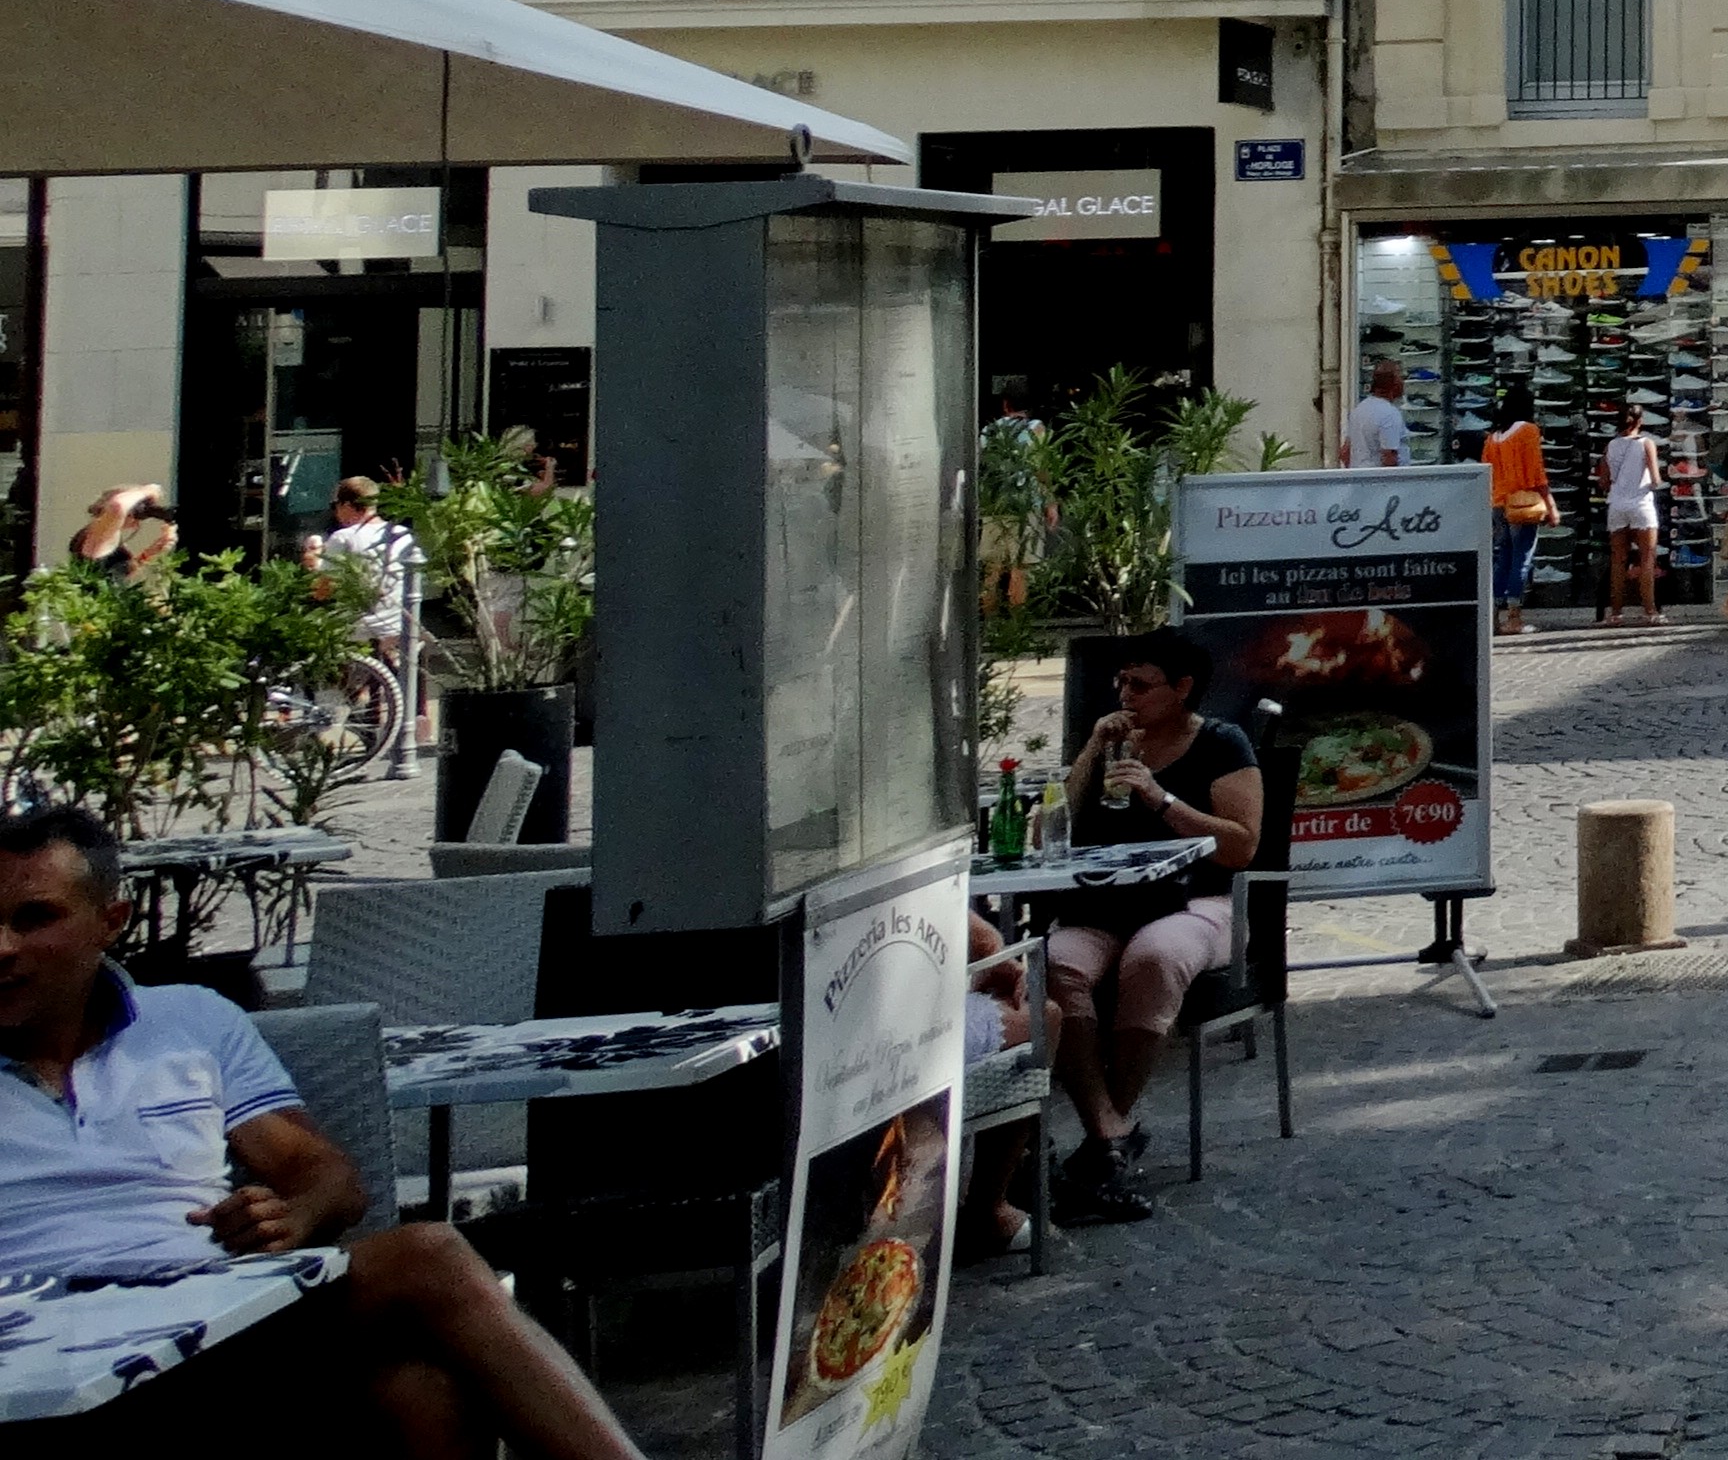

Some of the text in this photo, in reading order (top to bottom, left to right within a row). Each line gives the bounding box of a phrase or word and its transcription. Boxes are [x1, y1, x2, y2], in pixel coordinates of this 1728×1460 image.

[1077, 195, 1154, 216] GLACE
[1519, 244, 1621, 272] CANON
[1525, 270, 1621, 299] SHOES
[1215, 495, 1442, 549] Pizzeria les Arts
[1219, 558, 1458, 587] Ici les pizzas sont faites
[1344, 814, 1372, 833] de
[1402, 802, 1456, 826] 7€90
[824, 906, 949, 1013] Pizzeria les ARTS
